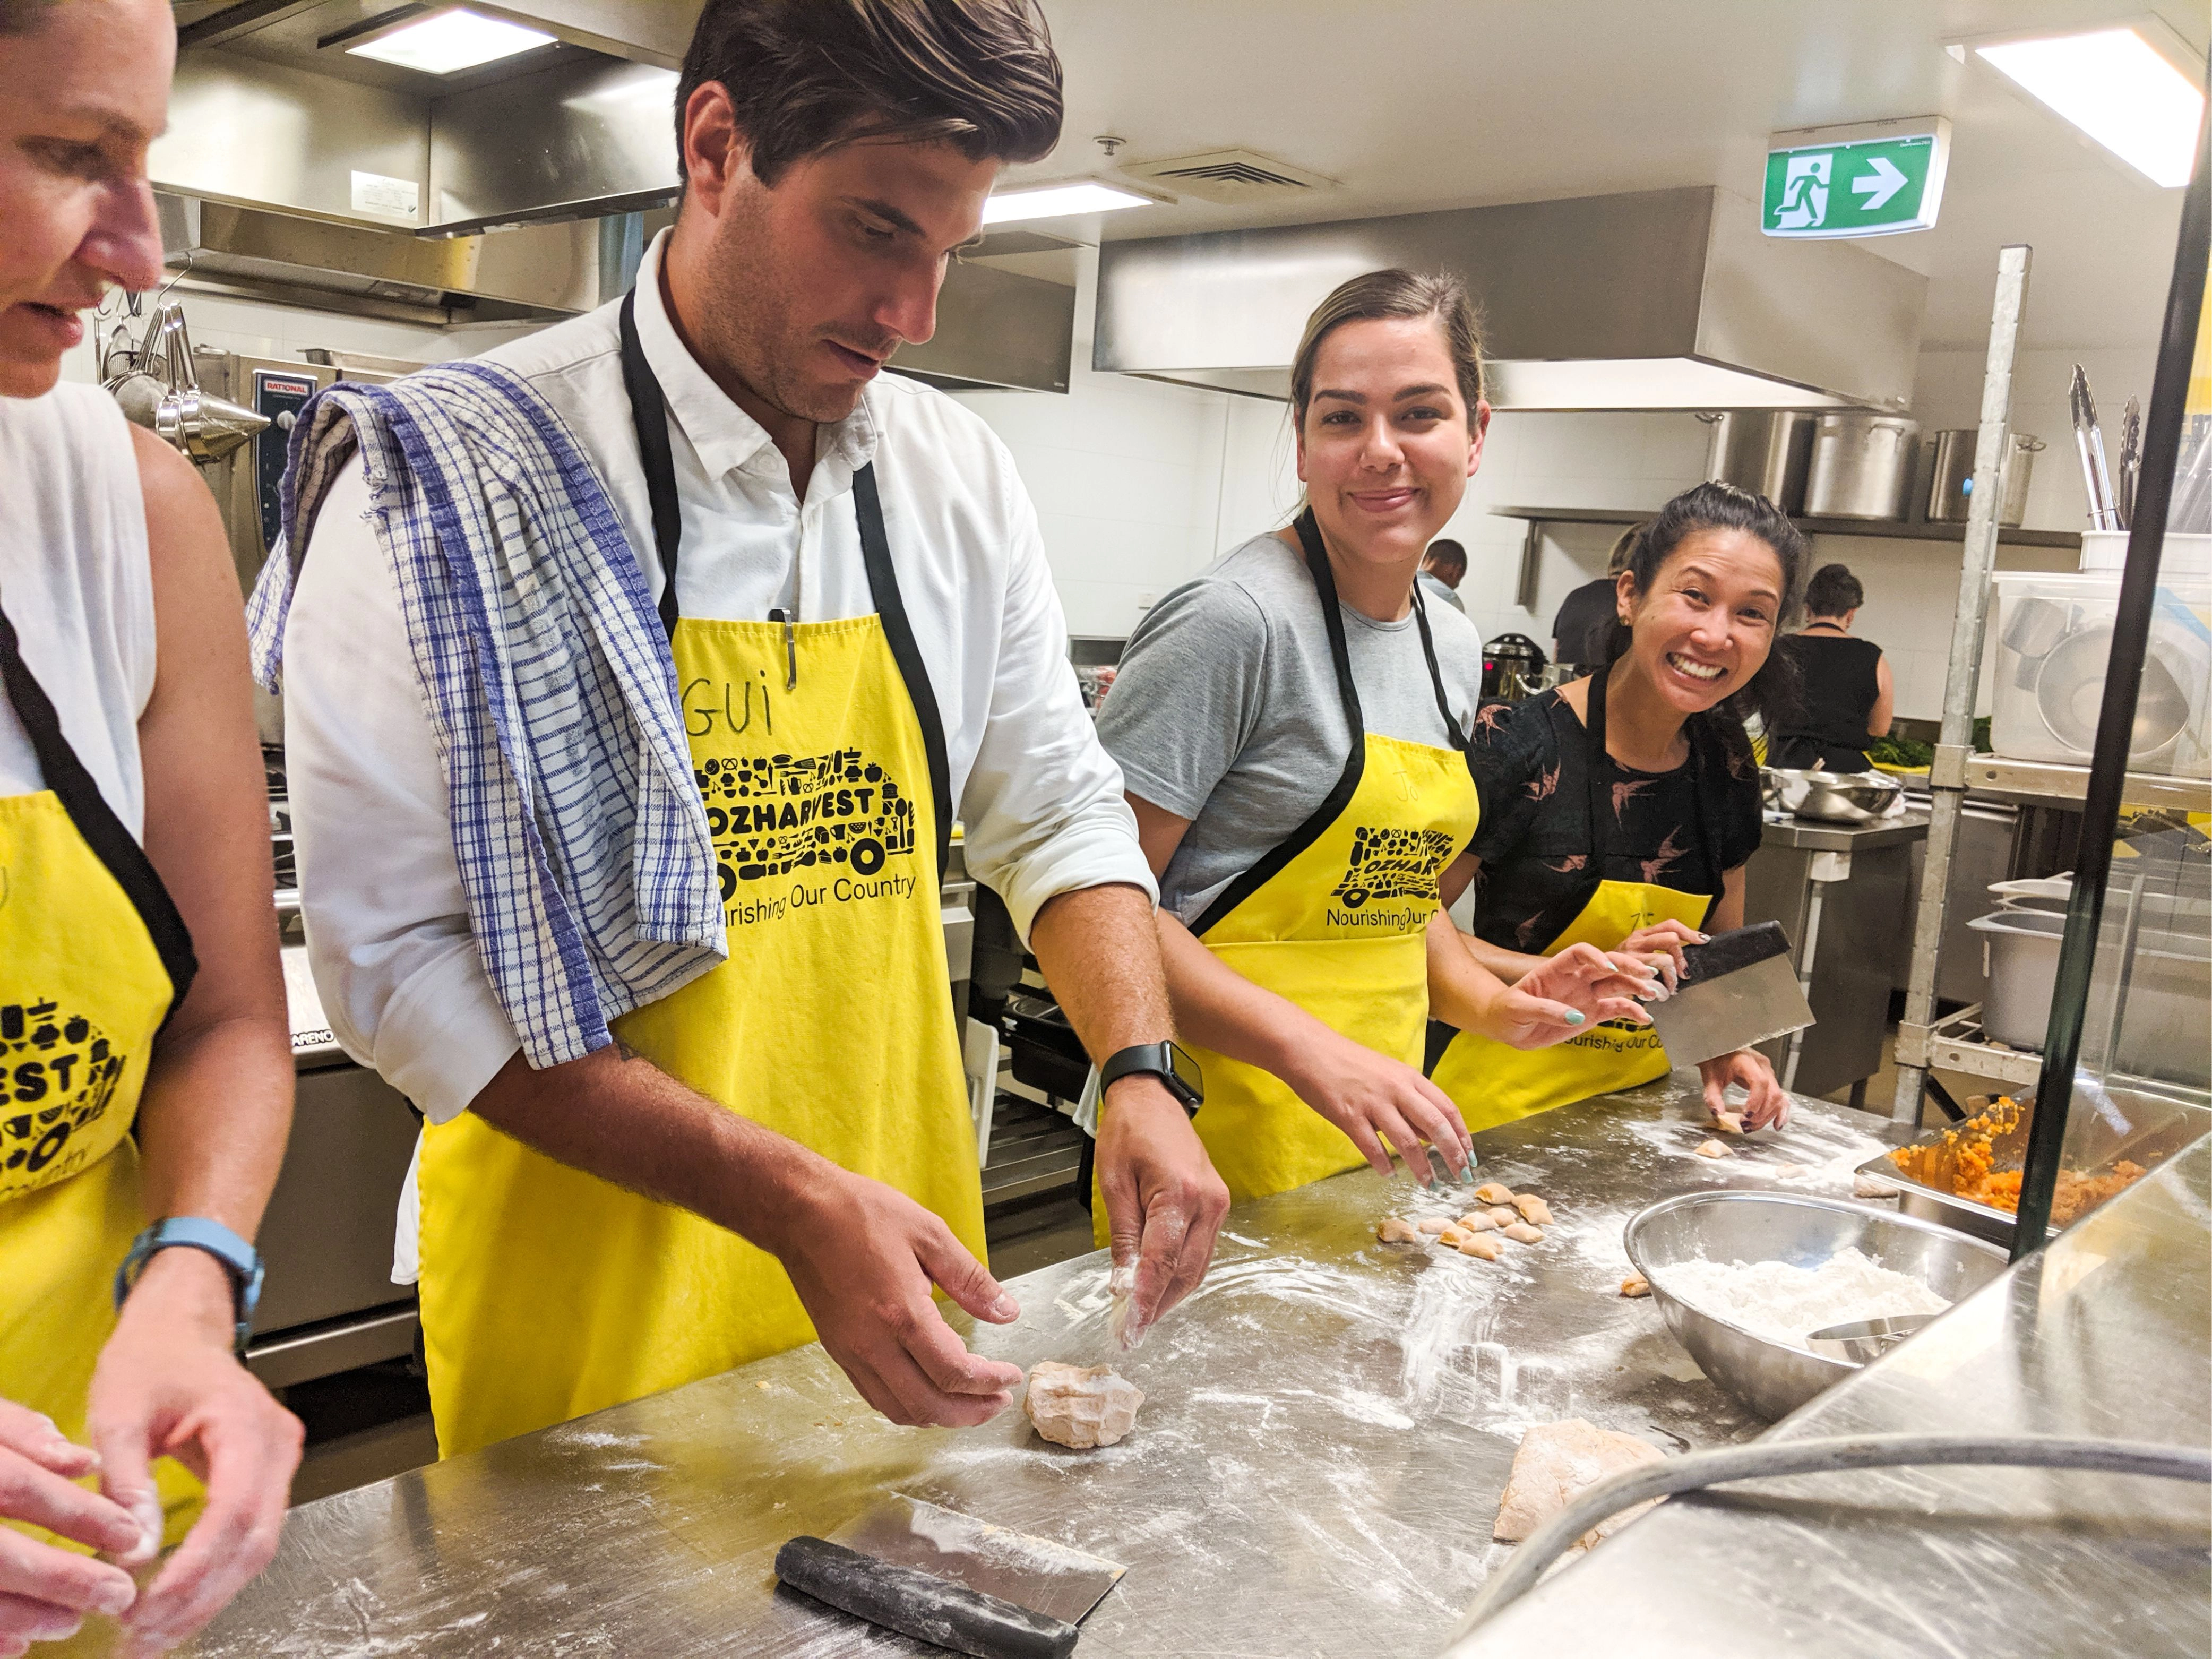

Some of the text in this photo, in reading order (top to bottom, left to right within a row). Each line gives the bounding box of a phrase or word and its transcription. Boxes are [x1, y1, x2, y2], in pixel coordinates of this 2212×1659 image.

[266, 382, 306, 393] RATIONAL
[705, 788, 875, 837] OZHARVEST
[1364, 859, 1432, 875] OZHAR
[791, 884, 827, 908] Our
[834, 873, 916, 902] Country
[1327, 908, 1406, 931] Nourishing
[291, 1029, 334, 1046] ARENO
